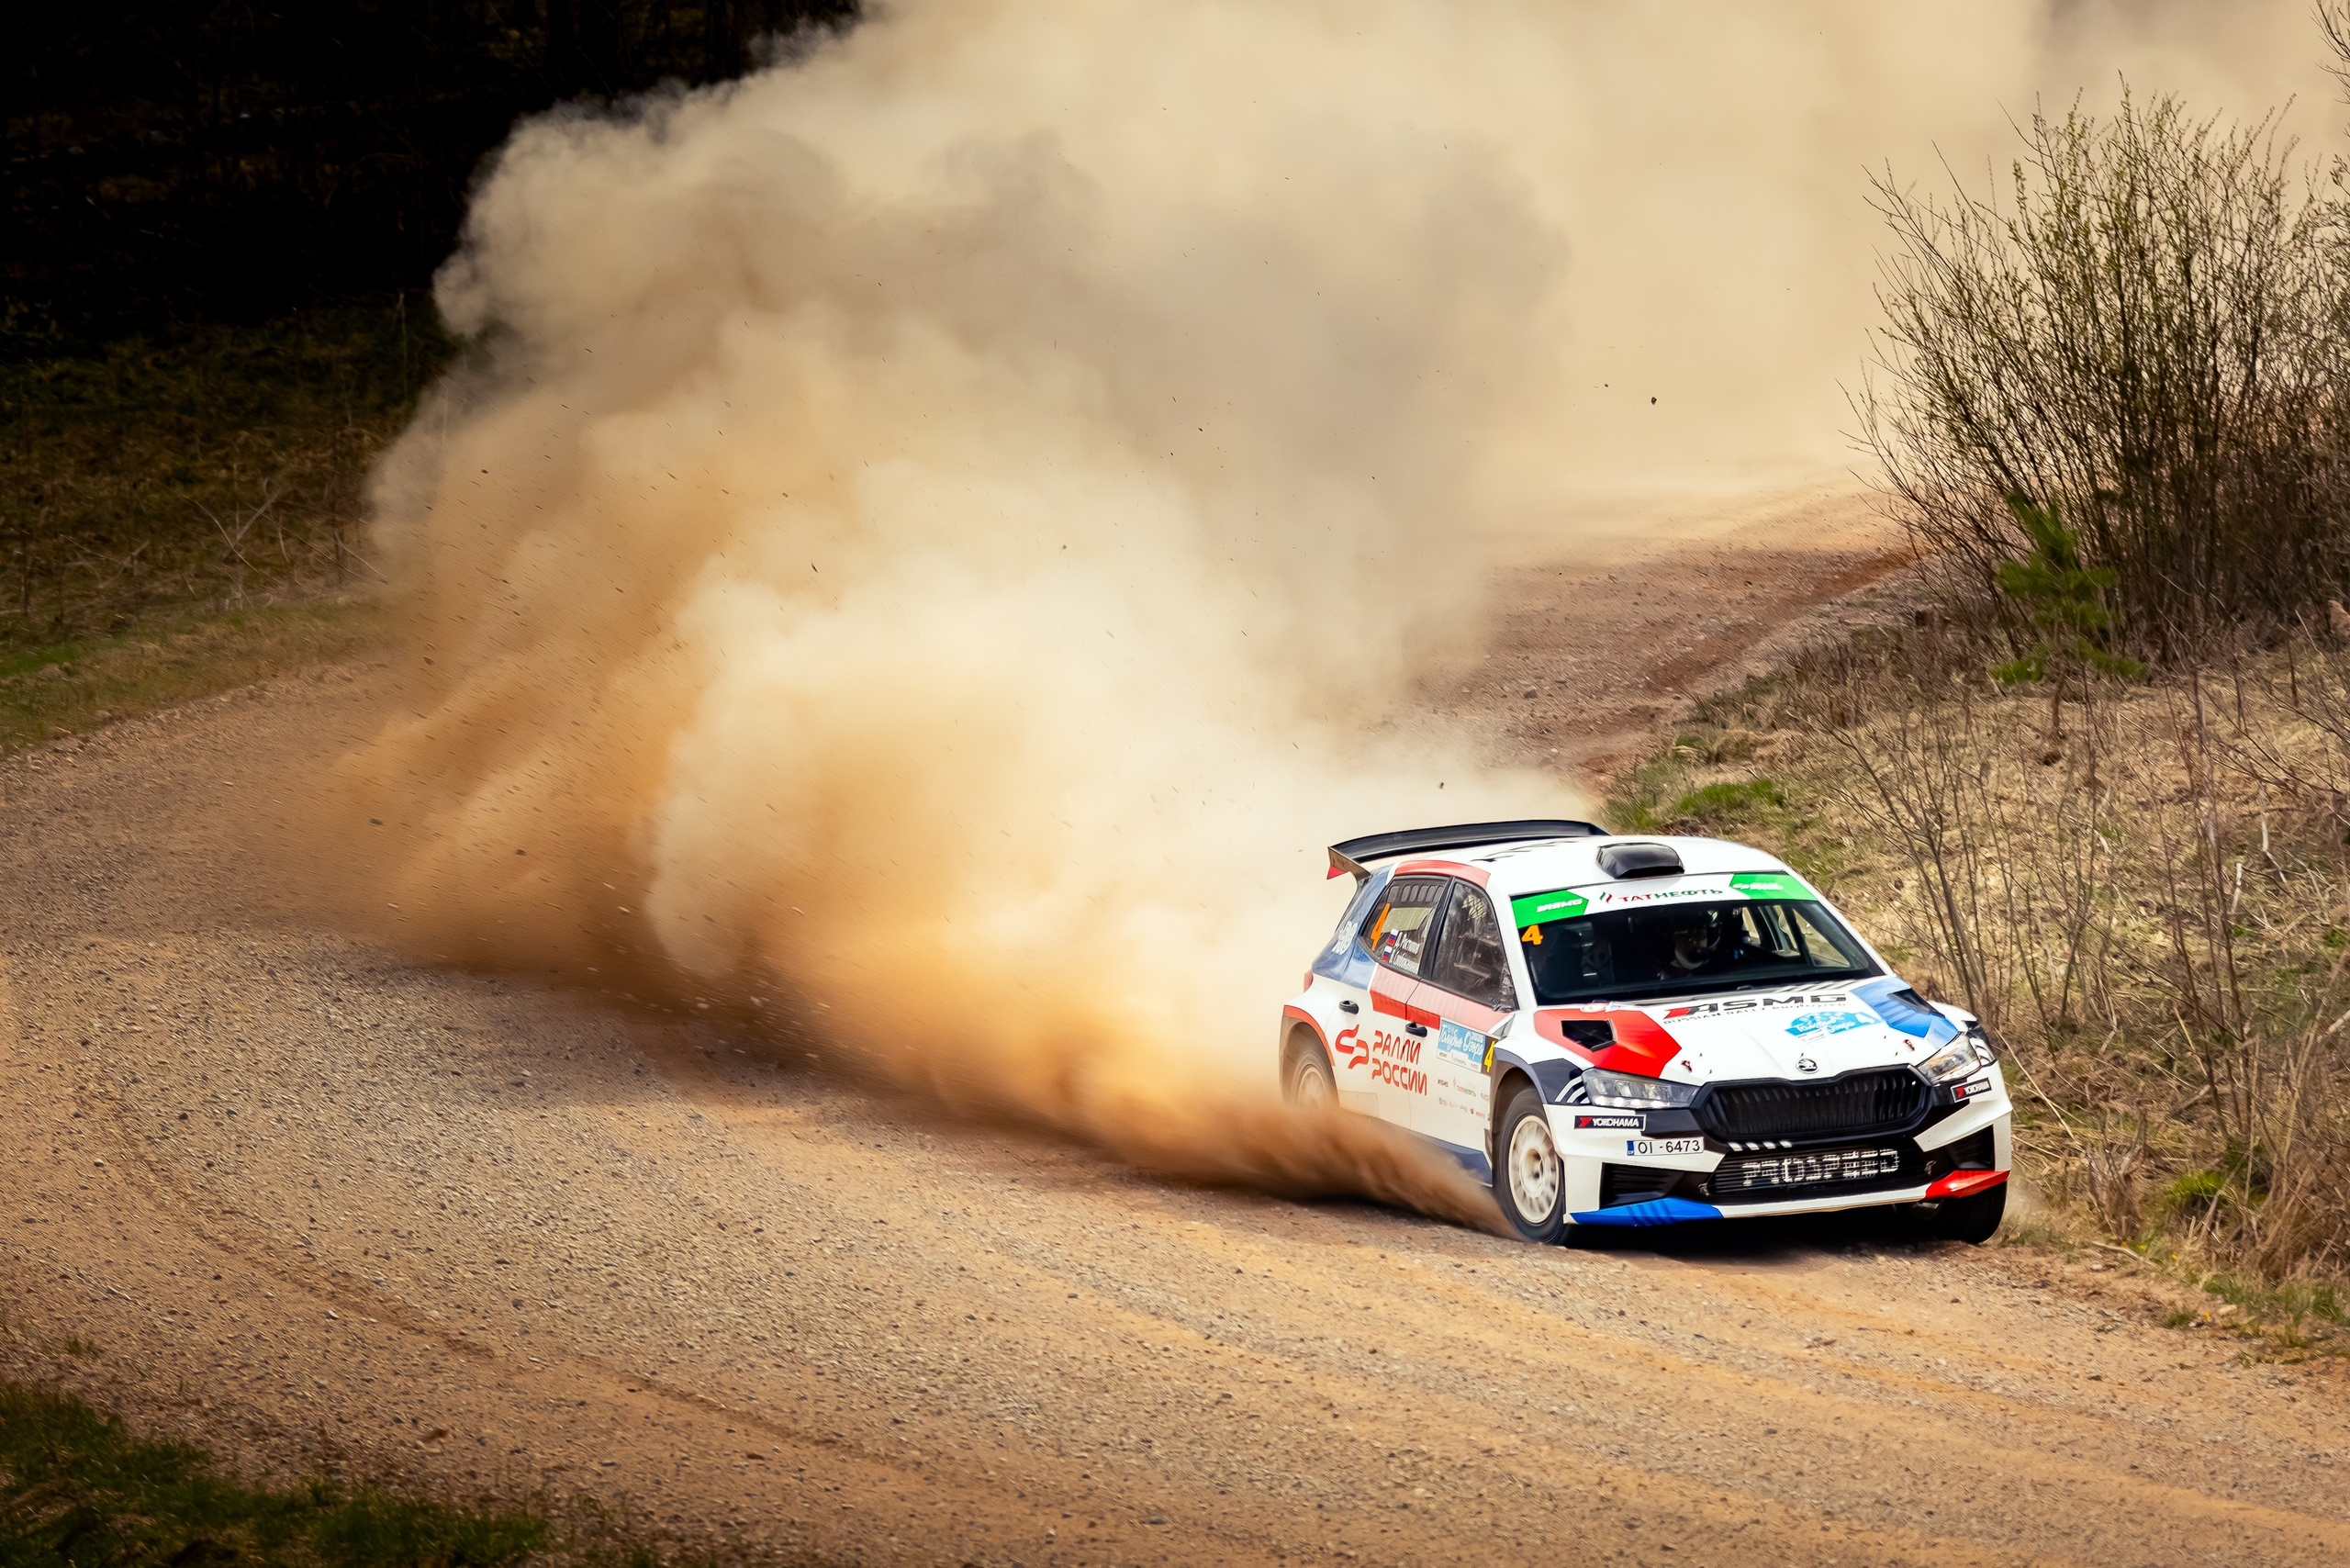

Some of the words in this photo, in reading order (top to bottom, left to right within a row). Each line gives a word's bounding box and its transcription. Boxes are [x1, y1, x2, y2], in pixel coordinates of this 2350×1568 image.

[1617, 889, 1724, 902] ТАТНЕФТЬ
[1371, 902, 1391, 952] 4
[1520, 924, 1544, 946] 4
[1685, 993, 1847, 1015] ASMG
[1372, 1030, 1421, 1065] РАЛЛИ
[1483, 1040, 1495, 1073] 4
[1371, 1058, 1427, 1097] РОССИИ
[1592, 1117, 1639, 1127] YOKOHAMA
